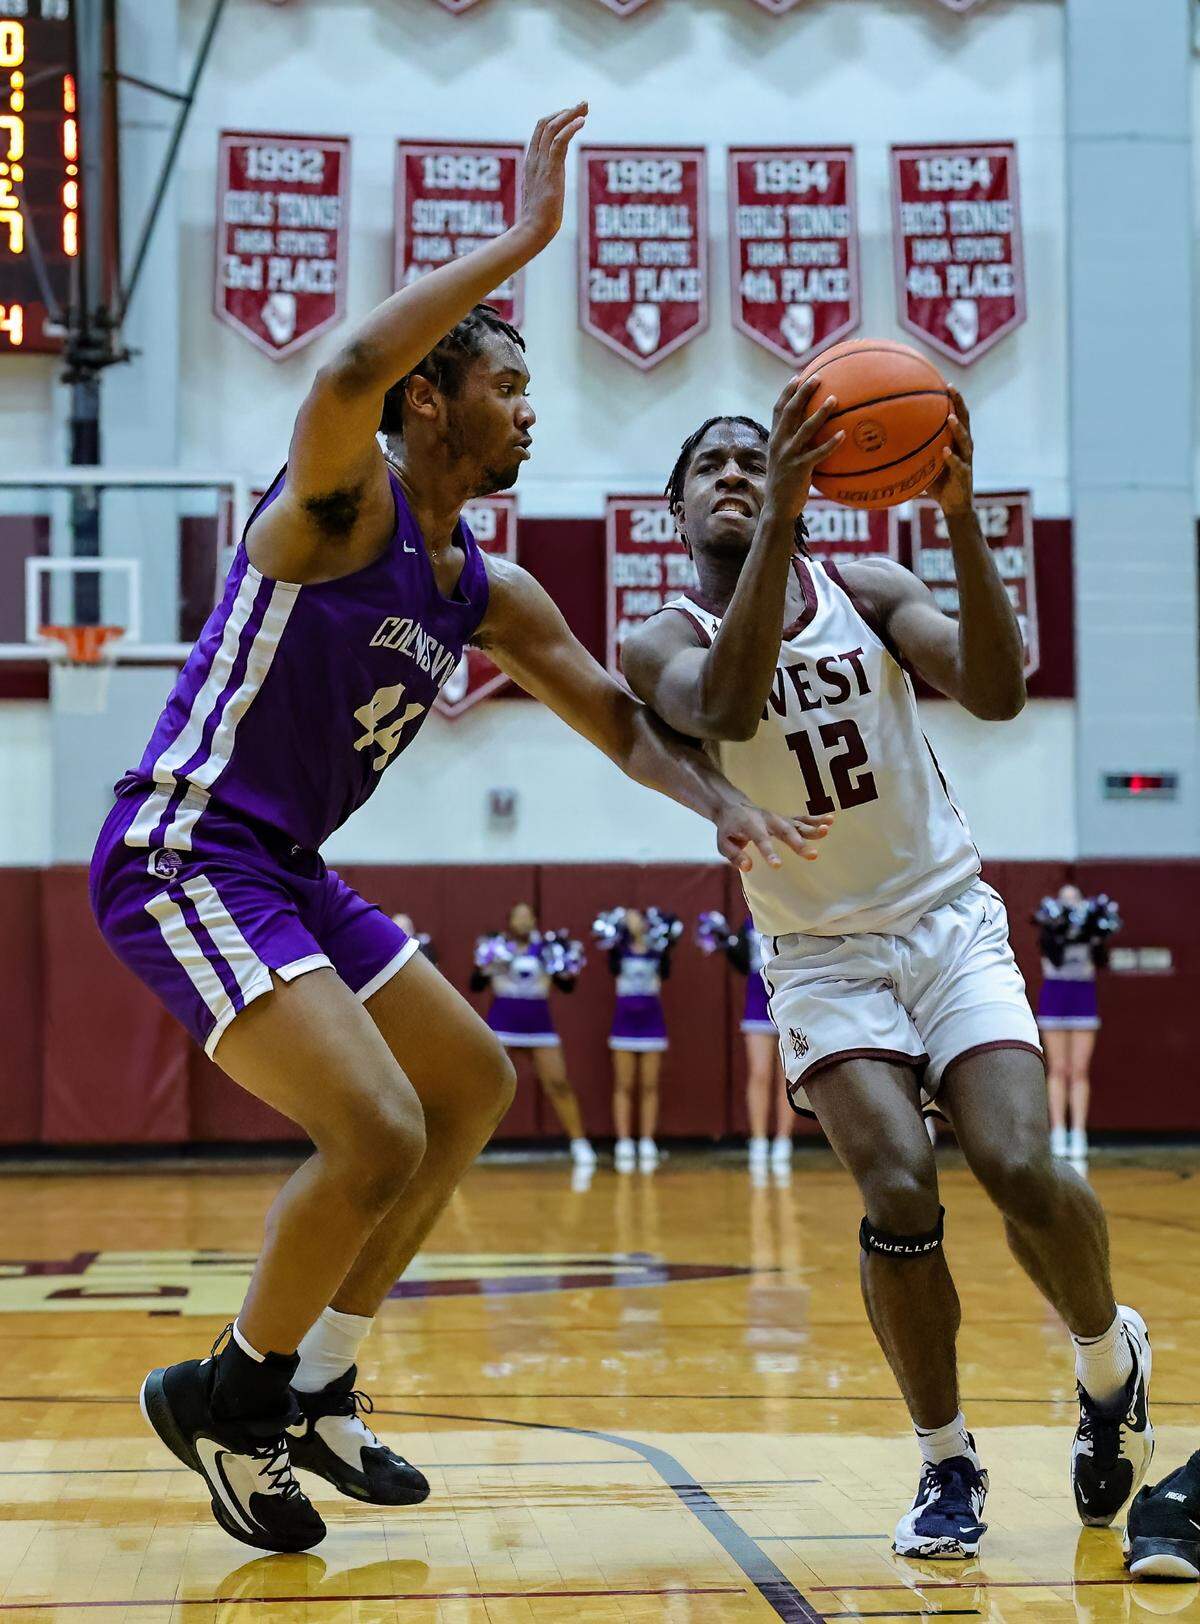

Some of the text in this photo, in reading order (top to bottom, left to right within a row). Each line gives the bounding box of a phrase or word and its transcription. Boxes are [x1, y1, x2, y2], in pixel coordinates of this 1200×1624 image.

[246, 148, 324, 184] 1992
[424, 156, 500, 190] 1992
[606, 161, 682, 193] 1992
[754, 161, 829, 193] 1994
[917, 158, 992, 191] 1994
[413, 200, 506, 232] SOFTBALL
[595, 205, 692, 238] BASEBALL
[268, 259, 336, 293] PLACE
[591, 269, 699, 302] 2nd PLACE
[782, 269, 849, 302] PLACE
[947, 264, 1014, 296] PLACE
[785, 719, 878, 816] 12
